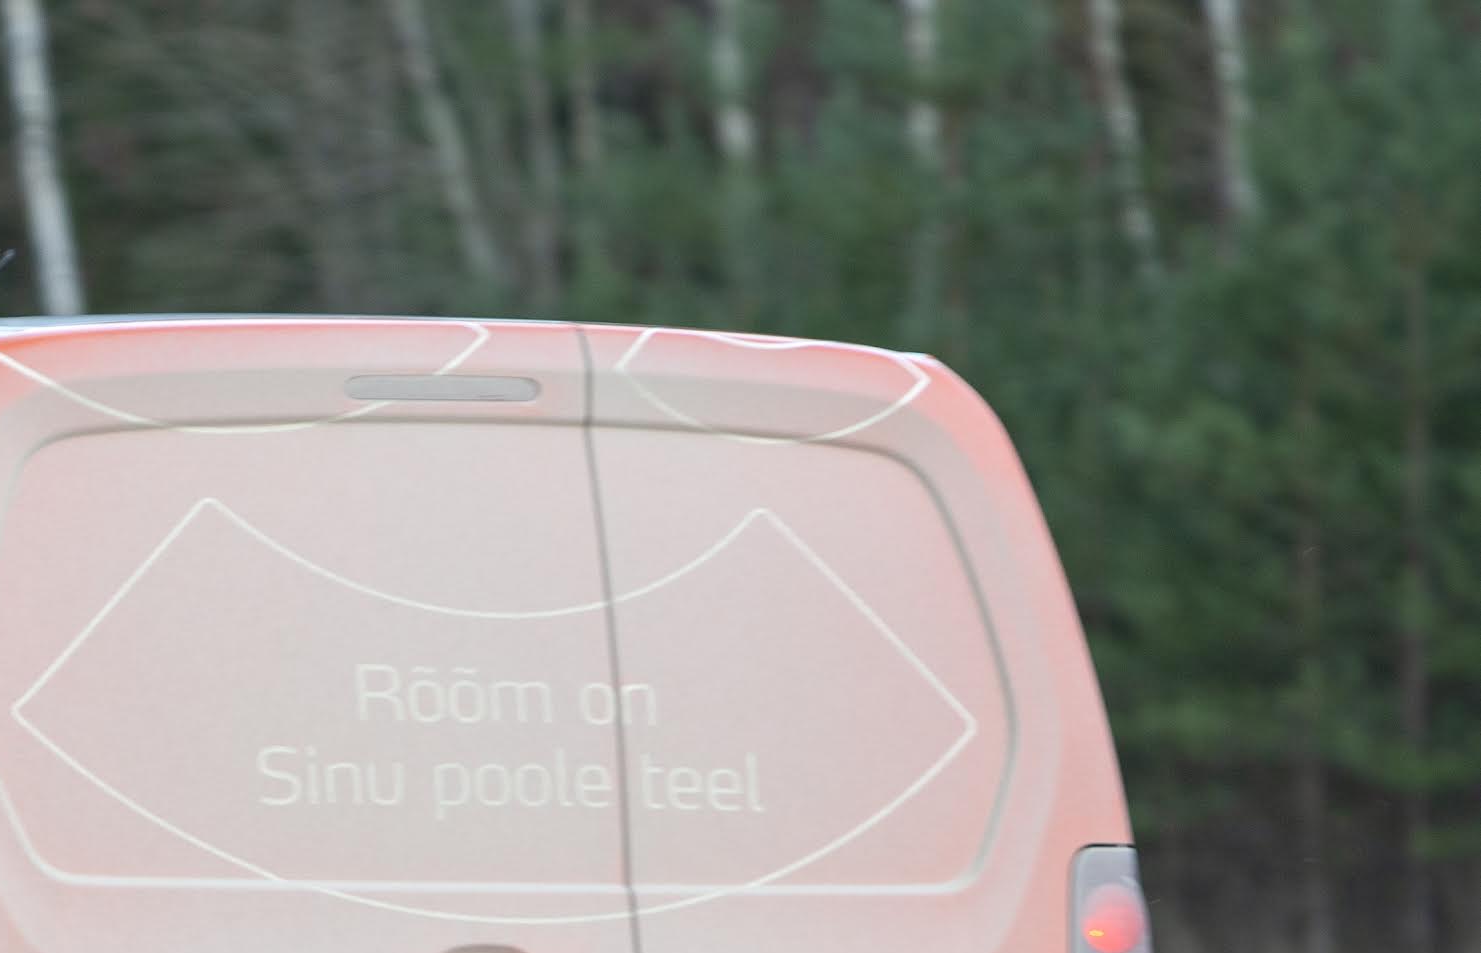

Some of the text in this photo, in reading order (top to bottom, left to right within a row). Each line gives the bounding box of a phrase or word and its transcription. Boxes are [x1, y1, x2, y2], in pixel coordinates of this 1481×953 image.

[354, 662, 658, 726] Rõõm on
[256, 745, 766, 820] Sinu poole teel
